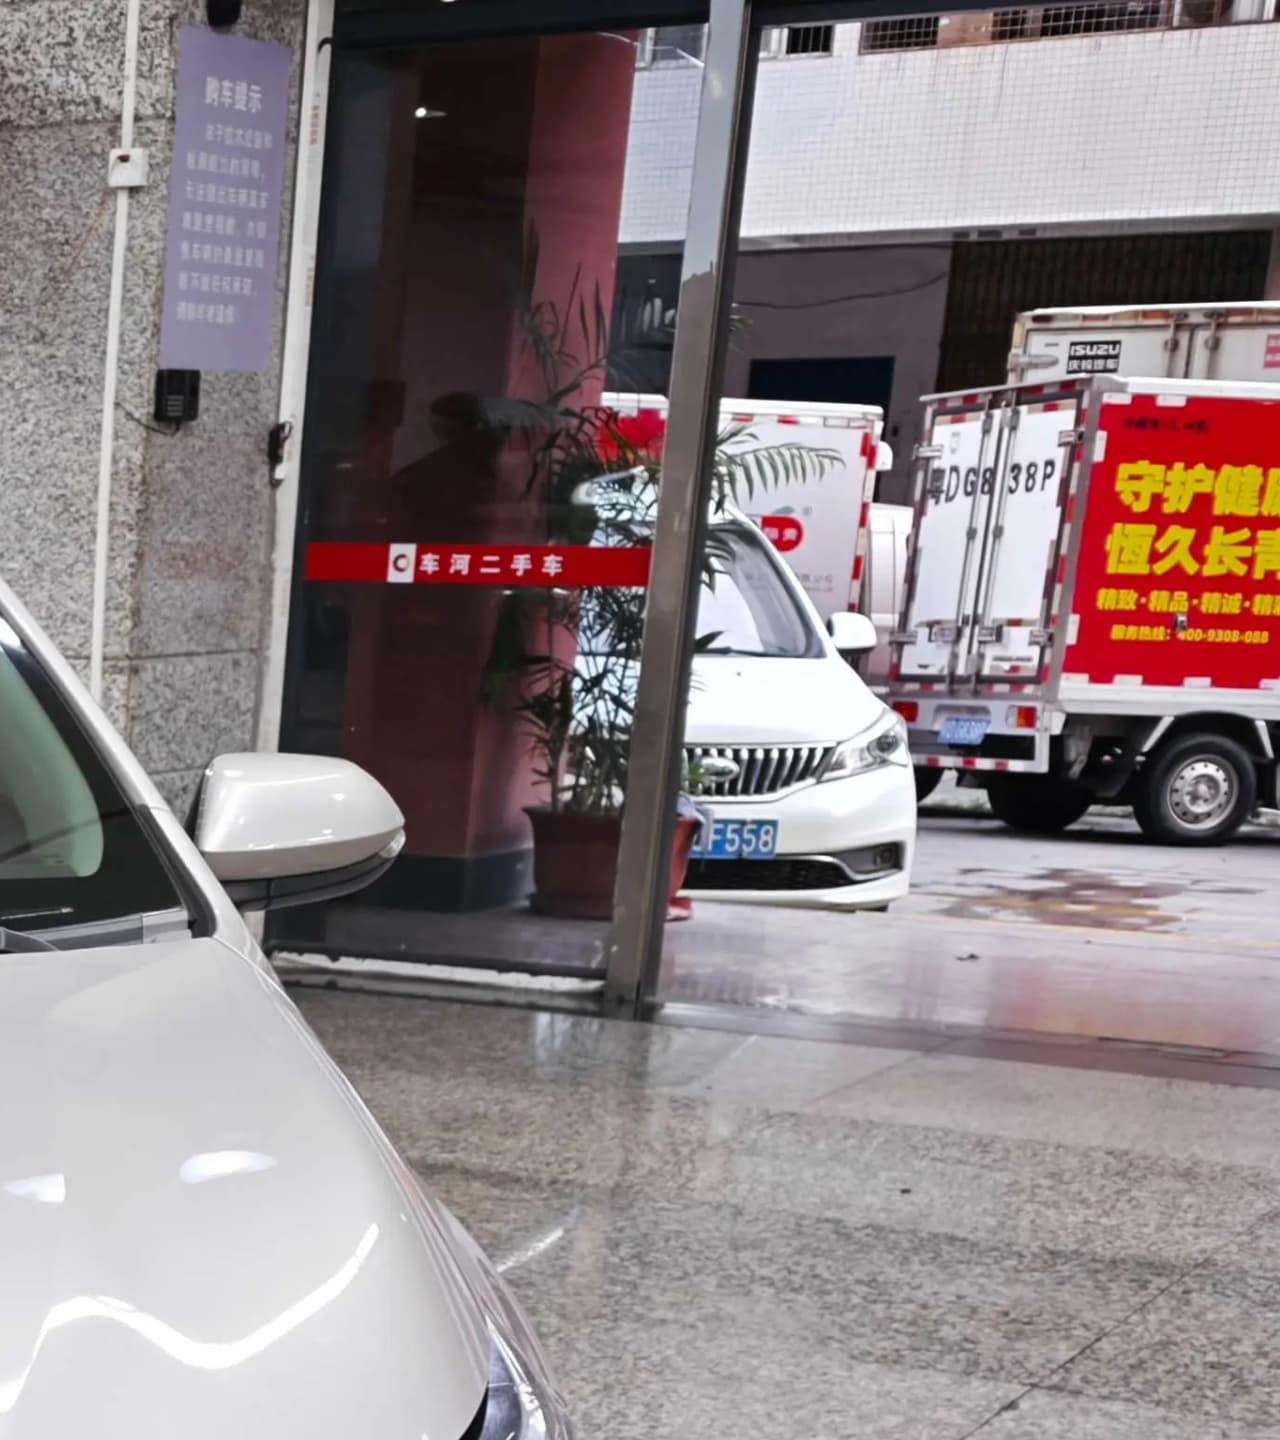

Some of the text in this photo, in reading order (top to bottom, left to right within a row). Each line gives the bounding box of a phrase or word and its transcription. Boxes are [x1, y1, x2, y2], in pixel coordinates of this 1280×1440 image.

[1070, 343, 1121, 357] ISUZU
[419, 553, 563, 577] 车河二手车
